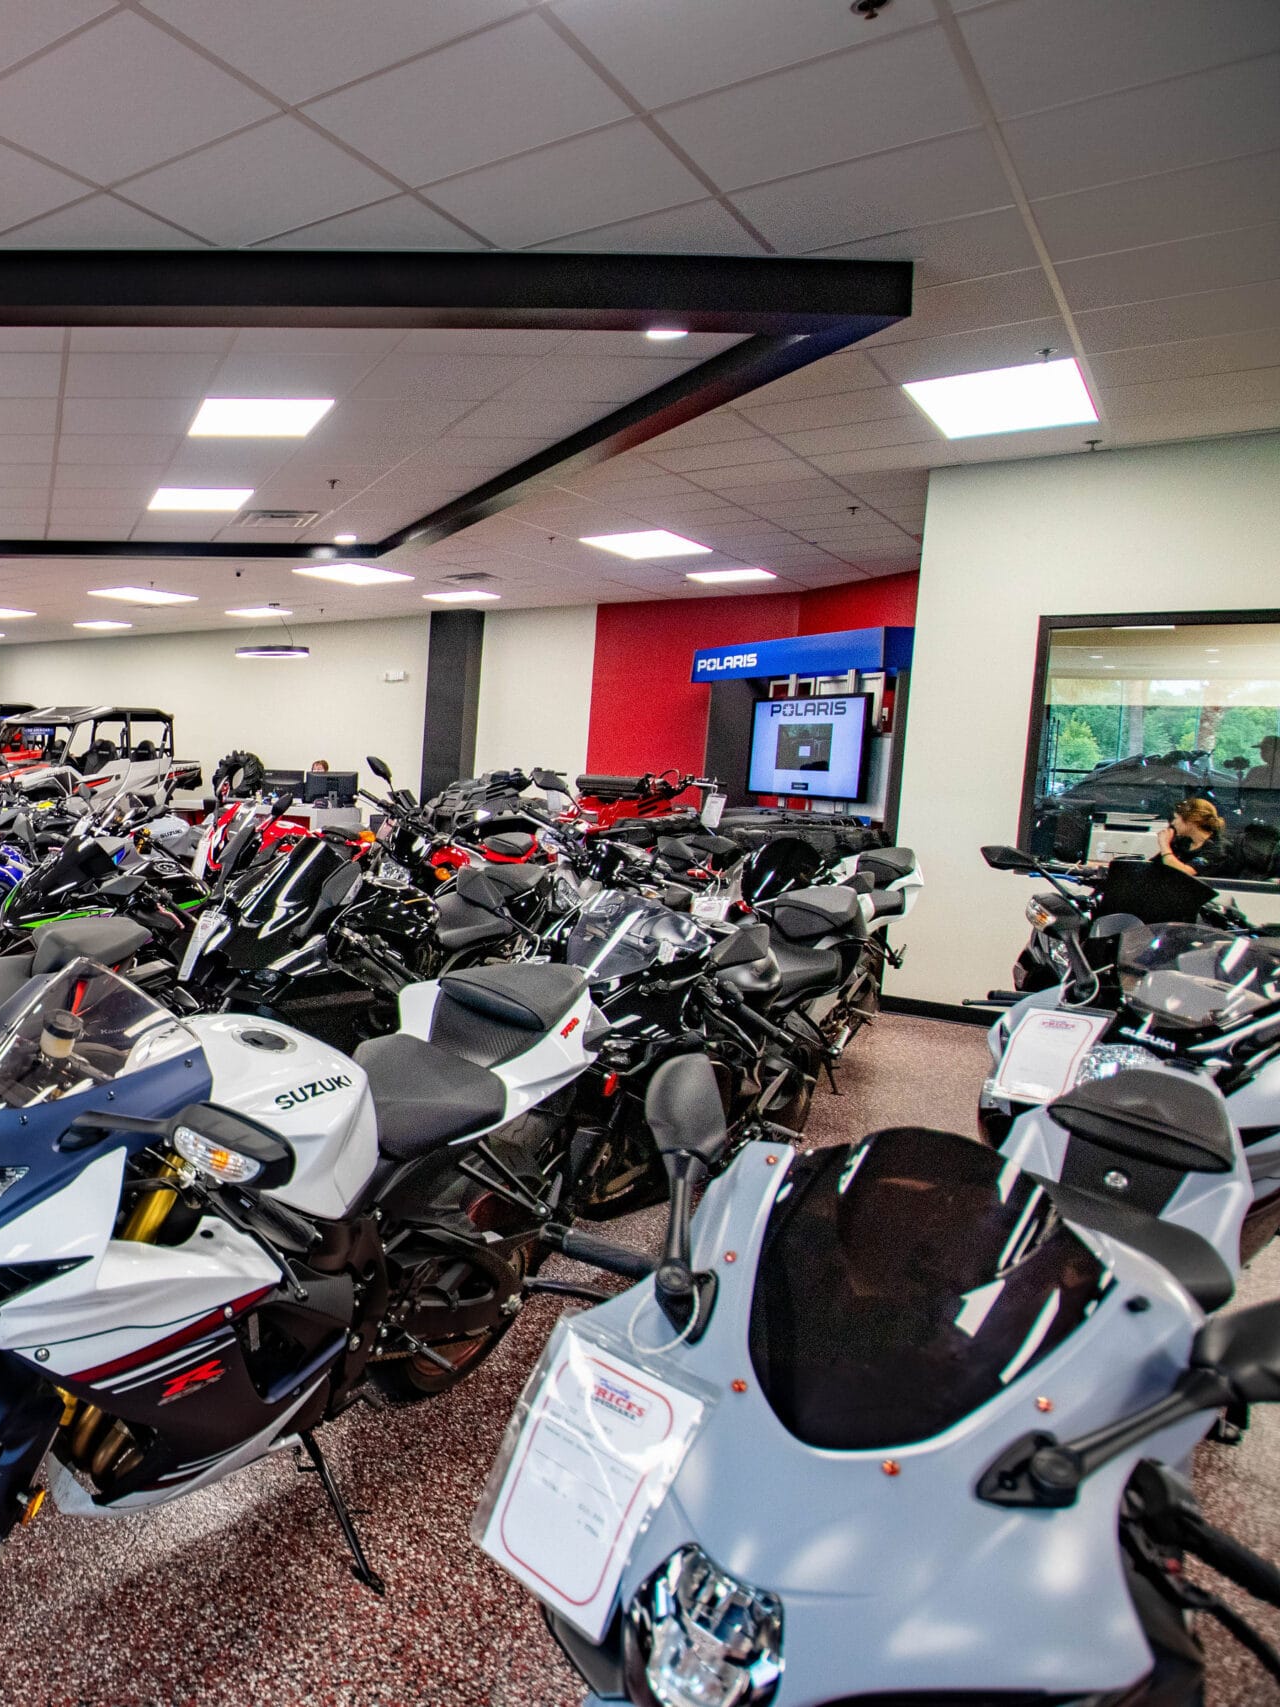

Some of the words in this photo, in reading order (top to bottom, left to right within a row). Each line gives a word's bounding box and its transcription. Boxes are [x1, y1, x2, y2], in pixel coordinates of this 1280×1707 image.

[697, 653, 757, 672] POLARIS
[770, 701, 846, 717] POLARIS
[160, 830, 183, 839] SUZUKI
[275, 1075, 353, 1110] SUZUKI
